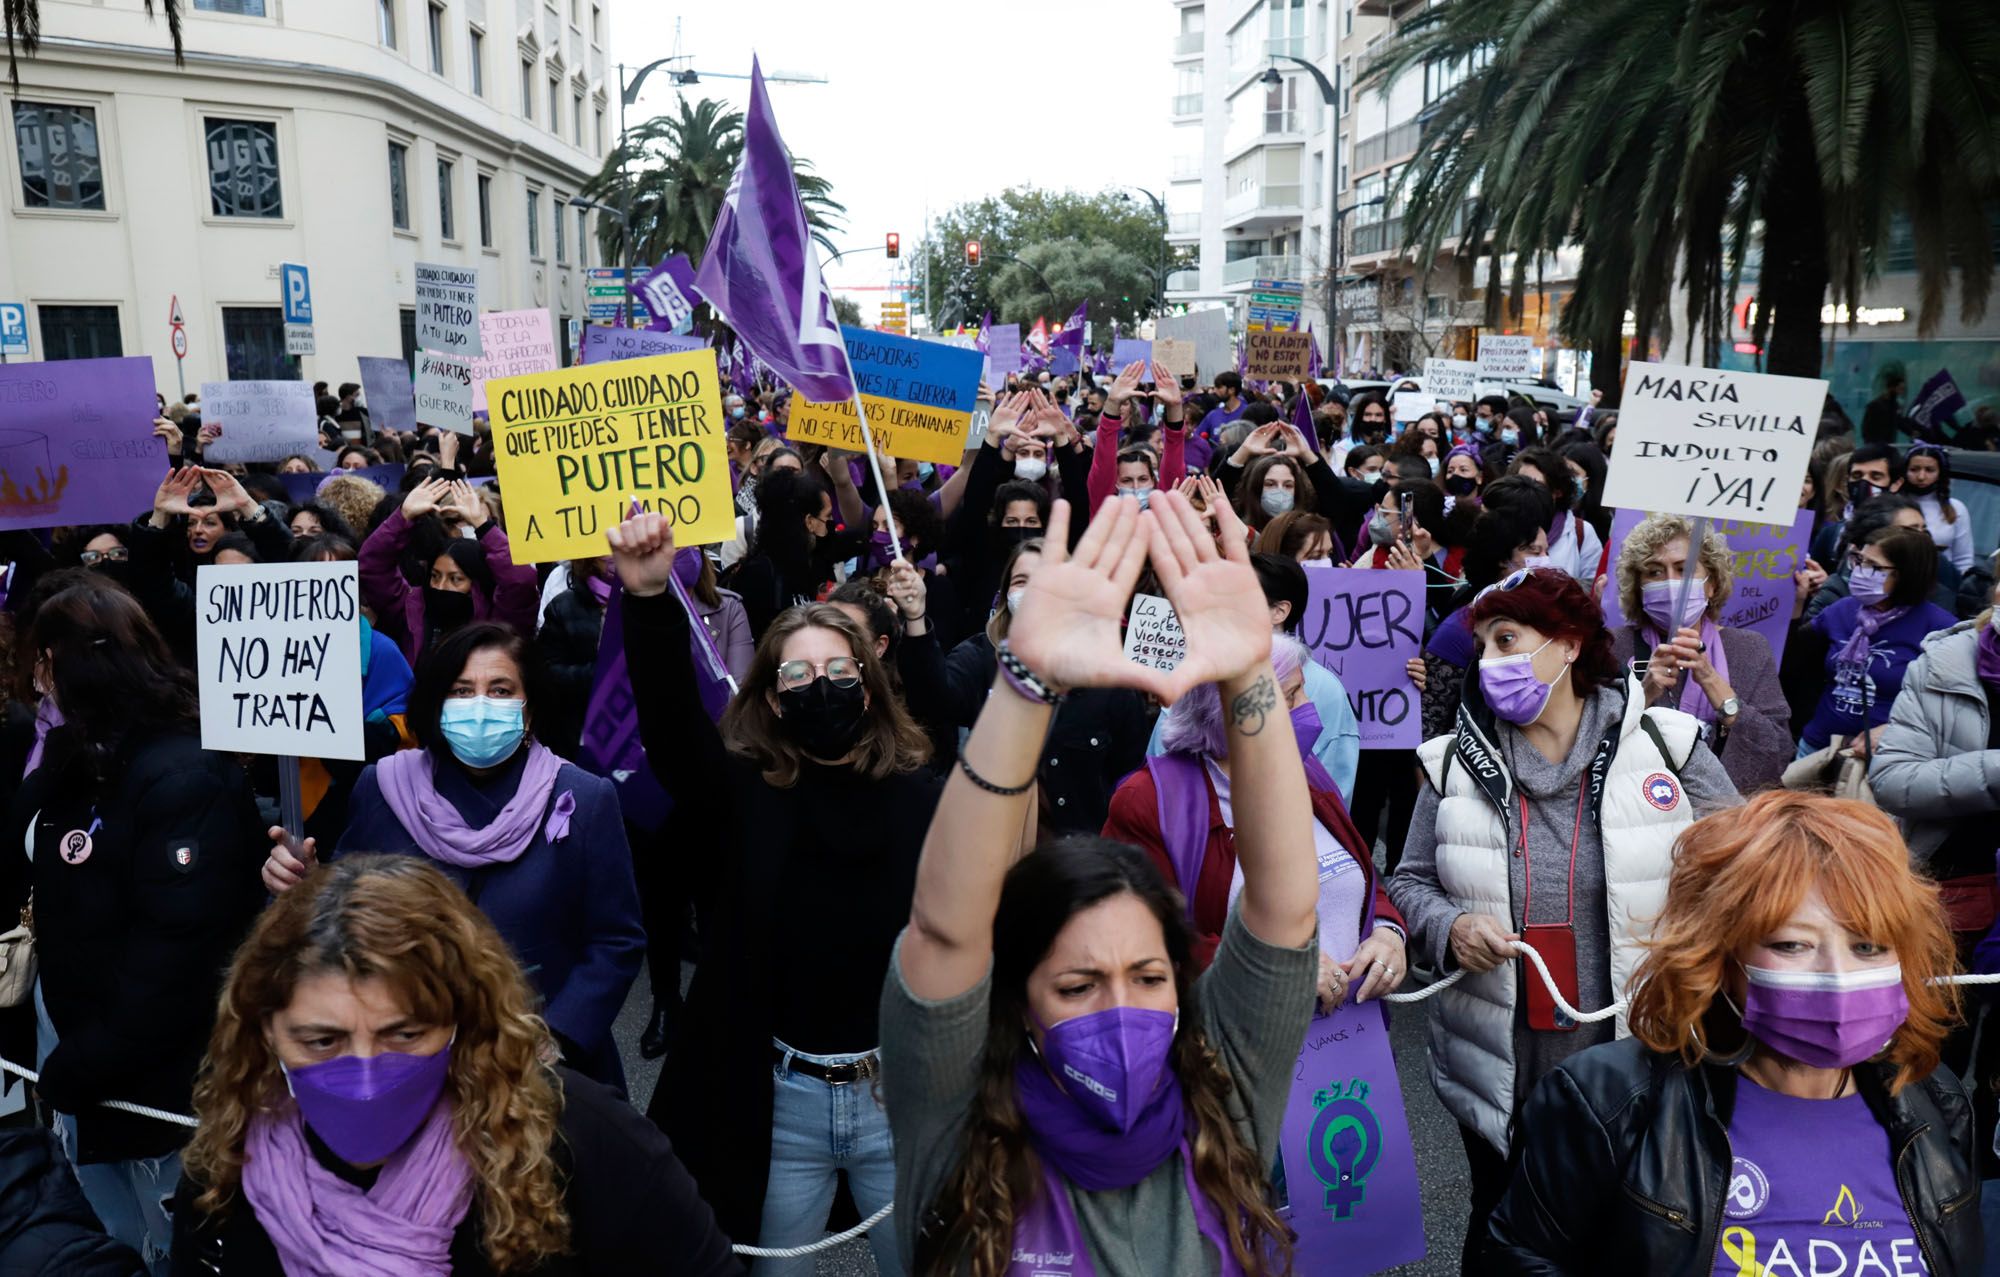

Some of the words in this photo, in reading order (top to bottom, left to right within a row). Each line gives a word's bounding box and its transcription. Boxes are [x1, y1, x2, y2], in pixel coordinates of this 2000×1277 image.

[288, 270, 305, 317] P
[449, 290, 475, 304] TENER
[1, 306, 22, 336] P
[421, 303, 431, 316] UN
[434, 305, 472, 328] PUTERO
[422, 324, 428, 336] A
[430, 326, 441, 339] TU
[445, 331, 467, 347] LADO
[513, 330, 531, 343] LA
[592, 334, 608, 345] SI
[615, 336, 636, 349] NO
[1250, 334, 1310, 349] CALLADITA
[1255, 350, 1270, 361] NO
[1273, 350, 1301, 361] ESTOY
[1431, 359, 1446, 368] LA
[421, 356, 472, 386] #HARTAS
[1429, 375, 1448, 386] NO
[602, 369, 701, 409] CUIDADO
[886, 377, 902, 398] DE
[908, 381, 958, 407] GUERRA
[1427, 386, 1468, 397] TRABAJO
[1635, 374, 1740, 403] MARÍA
[419, 393, 472, 421] GUERRAS
[505, 429, 541, 458] QUE
[544, 415, 619, 452] PUEDES
[631, 403, 712, 441] TENER
[797, 417, 819, 437] NO
[822, 420, 838, 441] SE
[1693, 411, 1806, 436] SEVILLA
[1634, 440, 1779, 463] INDULTO
[556, 441, 706, 496] PUTERO
[525, 513, 544, 541] A
[555, 504, 598, 538] TU
[206, 584, 243, 625] SIN
[249, 575, 356, 622] PUTEROS
[1741, 586, 1763, 597] DEL
[1135, 597, 1157, 616] La
[218, 635, 270, 683] NO
[281, 632, 331, 682] HAY
[1132, 641, 1185, 659] derecho
[1154, 657, 1174, 671] las
[232, 692, 336, 734] TRATA
[1307, 1028, 1349, 1051] VAMOS
[1356, 1024, 1365, 1033] A
[1853, 1221, 1883, 1229] ESTATAL
[1761, 1239, 1930, 1277] ADAE
